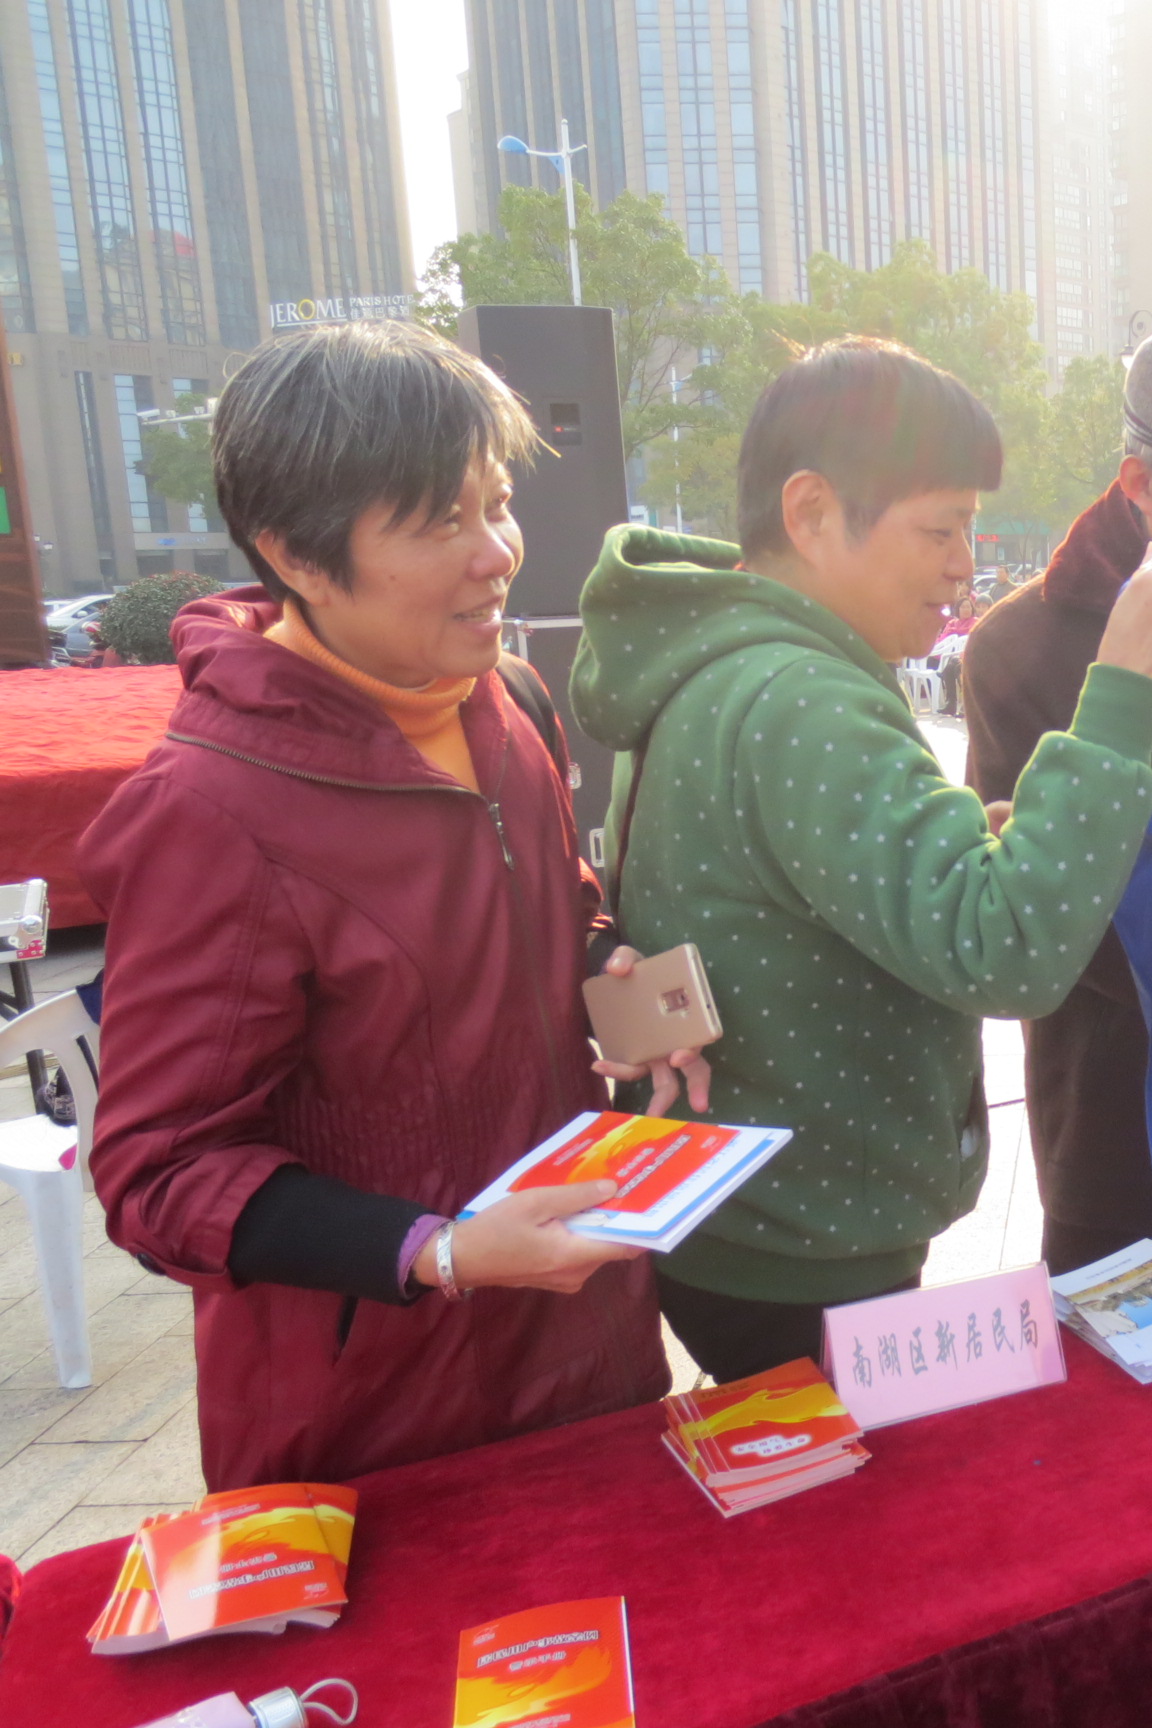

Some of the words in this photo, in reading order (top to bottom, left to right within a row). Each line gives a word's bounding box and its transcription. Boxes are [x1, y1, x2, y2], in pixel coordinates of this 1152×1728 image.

[270, 298, 347, 328] JEROME
[349, 296, 382, 307] PARIS
[383, 294, 415, 306] HOTE
[851, 1298, 1039, 1389] 南湖区新居民局
